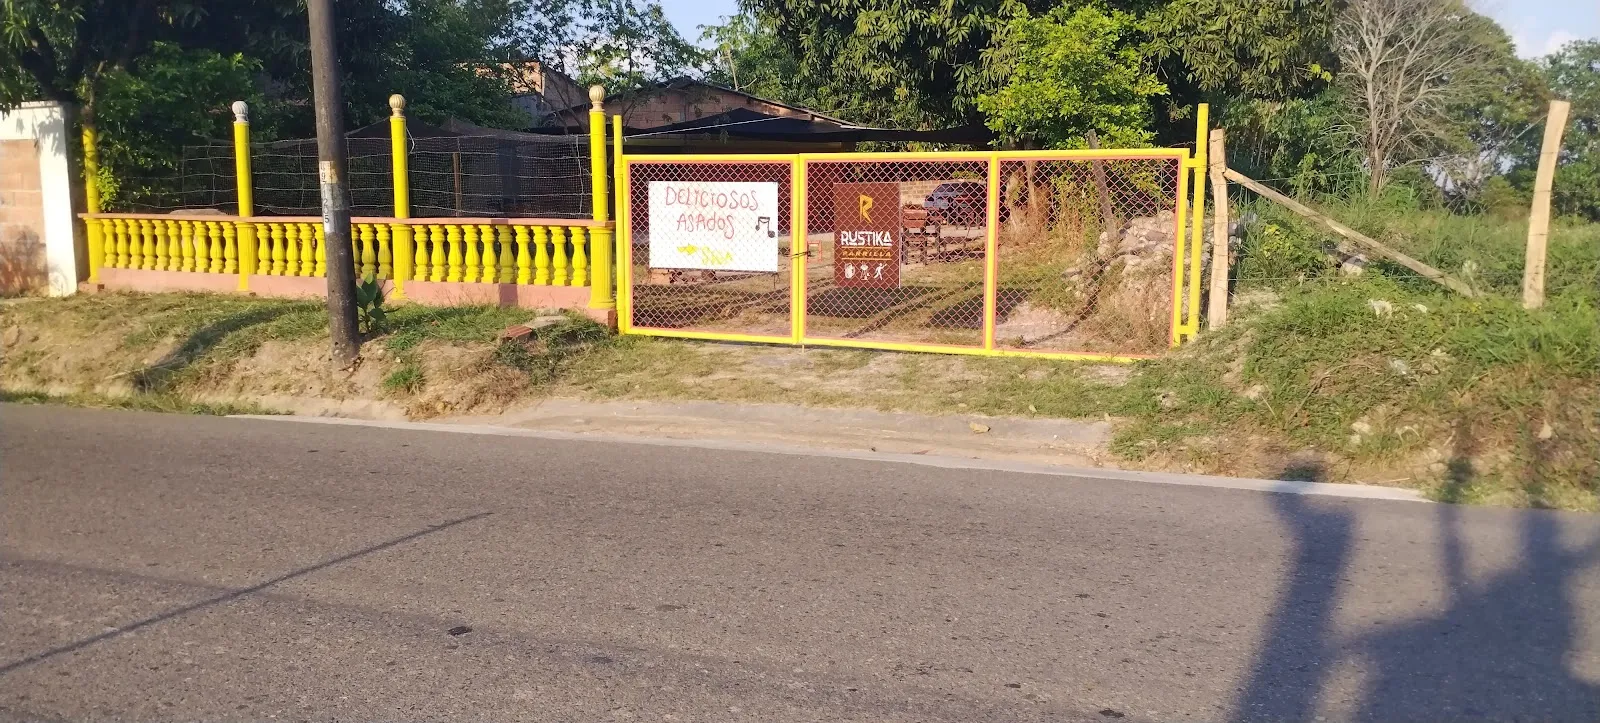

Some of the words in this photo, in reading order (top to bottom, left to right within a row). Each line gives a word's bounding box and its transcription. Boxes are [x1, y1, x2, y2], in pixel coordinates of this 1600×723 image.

[860, 194, 873, 224] R
[841, 231, 893, 246] RUSTIKA
[842, 249, 892, 257] PARRILLA
